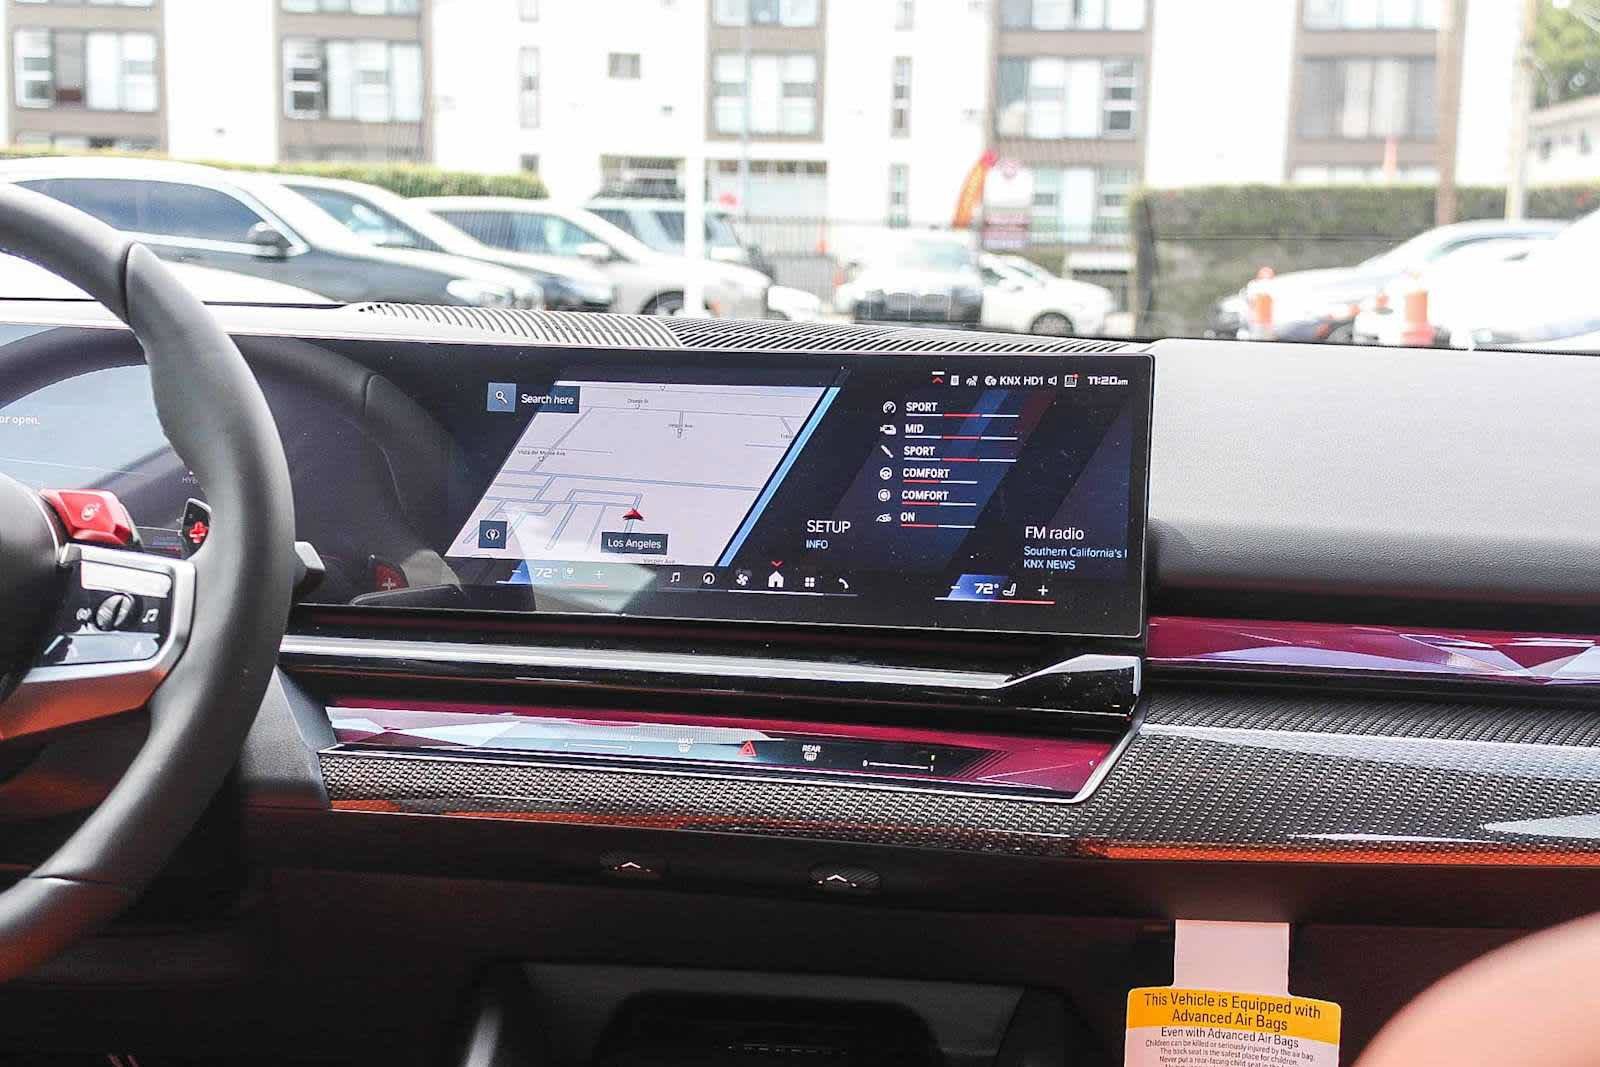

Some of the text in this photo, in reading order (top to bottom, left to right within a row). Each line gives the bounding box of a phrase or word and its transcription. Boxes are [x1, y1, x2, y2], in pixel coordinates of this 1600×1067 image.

[1000, 376, 1044, 386] KNX HD1
[520, 393, 574, 405] Search here
[905, 401, 938, 412] SPORT
[904, 423, 924, 434] MID
[903, 446, 936, 456] SPORT
[902, 468, 950, 478] COMFORT
[901, 490, 949, 500] COMFORT
[900, 512, 916, 522] ON
[806, 519, 851, 534] SETUP
[1025, 525, 1085, 541] FM radio
[607, 538, 662, 550] Los Angeles
[805, 539, 829, 549] INFO
[1023, 546, 1067, 557] Southern
[1069, 547, 1122, 559] California's
[1023, 559, 1076, 570] KNX NEWS
[802, 744, 821, 753] REAR
[1144, 992, 1321, 1019] This Vehicle is Equipped with
[1172, 1008, 1288, 1032] Advanced Air Bags
[1161, 1026, 1299, 1049] Even with Advanced Air Bags
